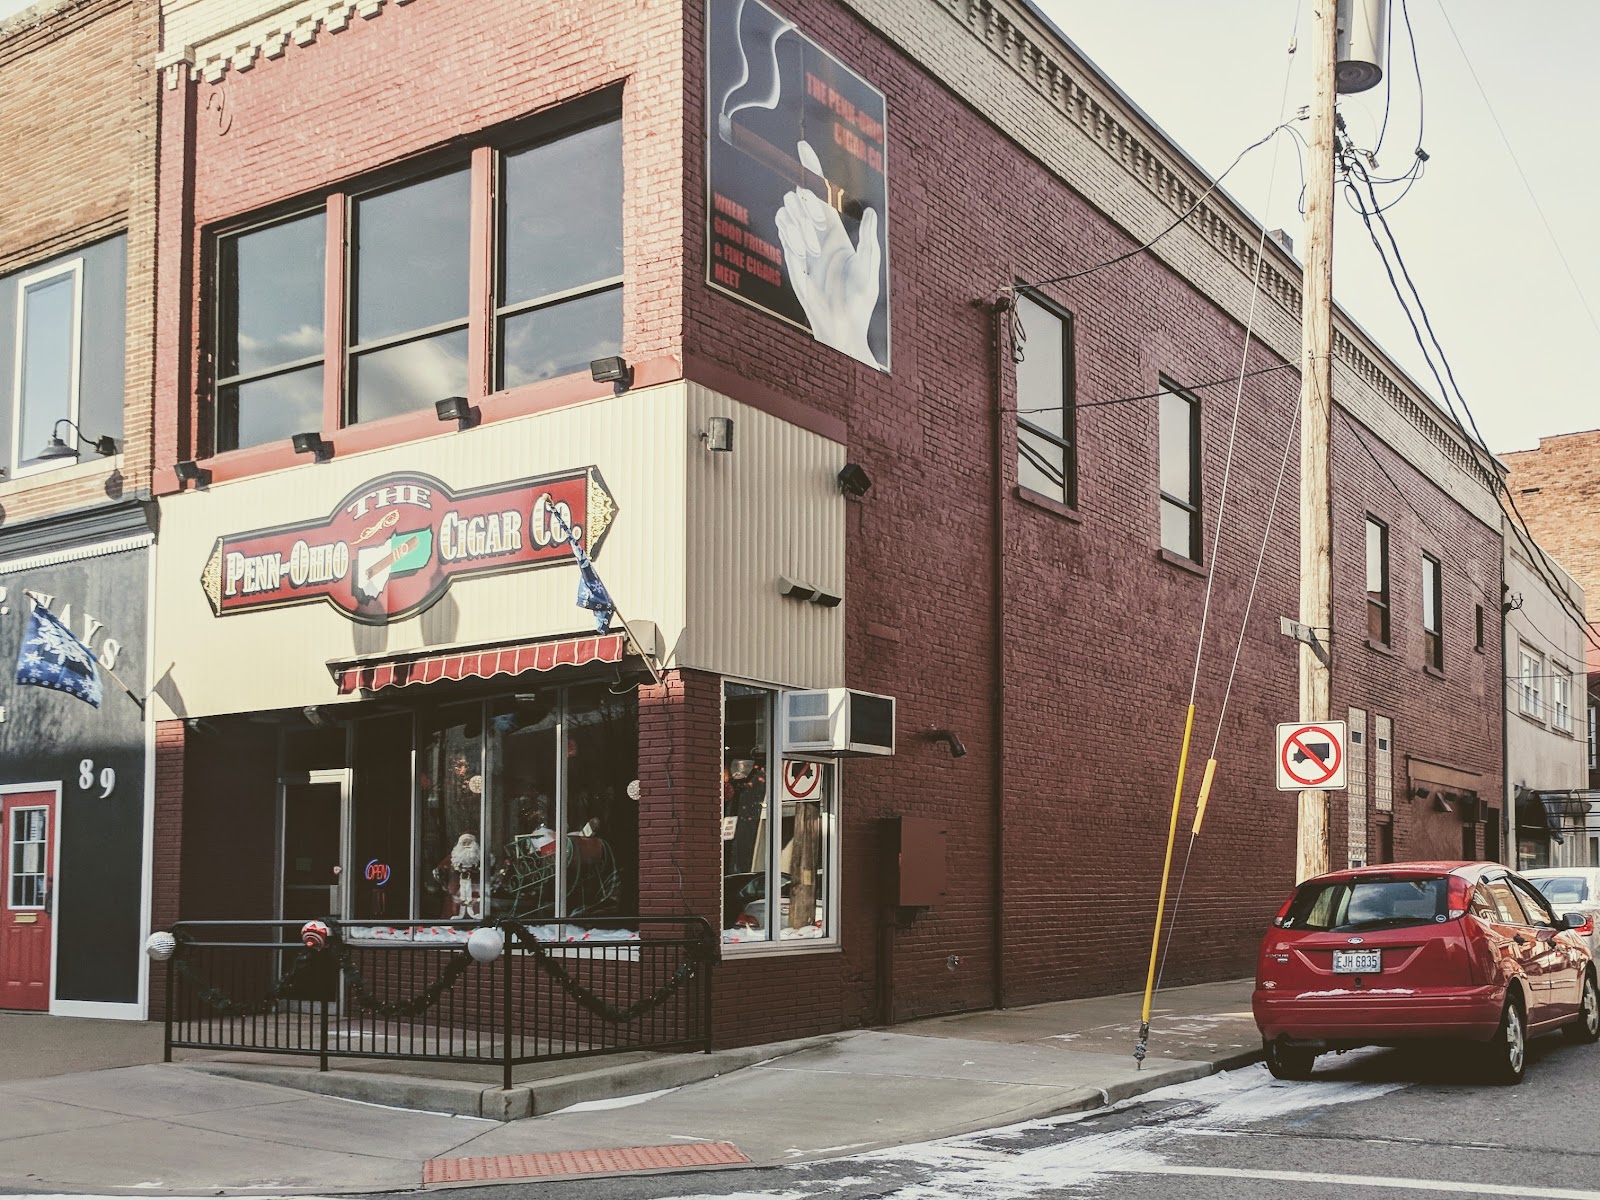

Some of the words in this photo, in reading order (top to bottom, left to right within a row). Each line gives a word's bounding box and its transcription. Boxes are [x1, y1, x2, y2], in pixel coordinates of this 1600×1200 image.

[714, 191, 749, 227] WHERE
[713, 216, 743, 246] GOOD
[743, 230, 783, 267] FRIENDS
[714, 241, 723, 257] &
[723, 243, 745, 270] FINE
[746, 254, 782, 287] CIGARS
[714, 262, 740, 289] MEET
[347, 484, 432, 520] THE
[225, 540, 349, 596] PENN-OHIO
[438, 509, 522, 561] CIGAR
[532, 493, 582, 546] CO.
[79, 758, 117, 799] 89
[367, 864, 389, 880] OPEN
[1336, 955, 1353, 969] EJH
[1355, 955, 1378, 968] 6835
